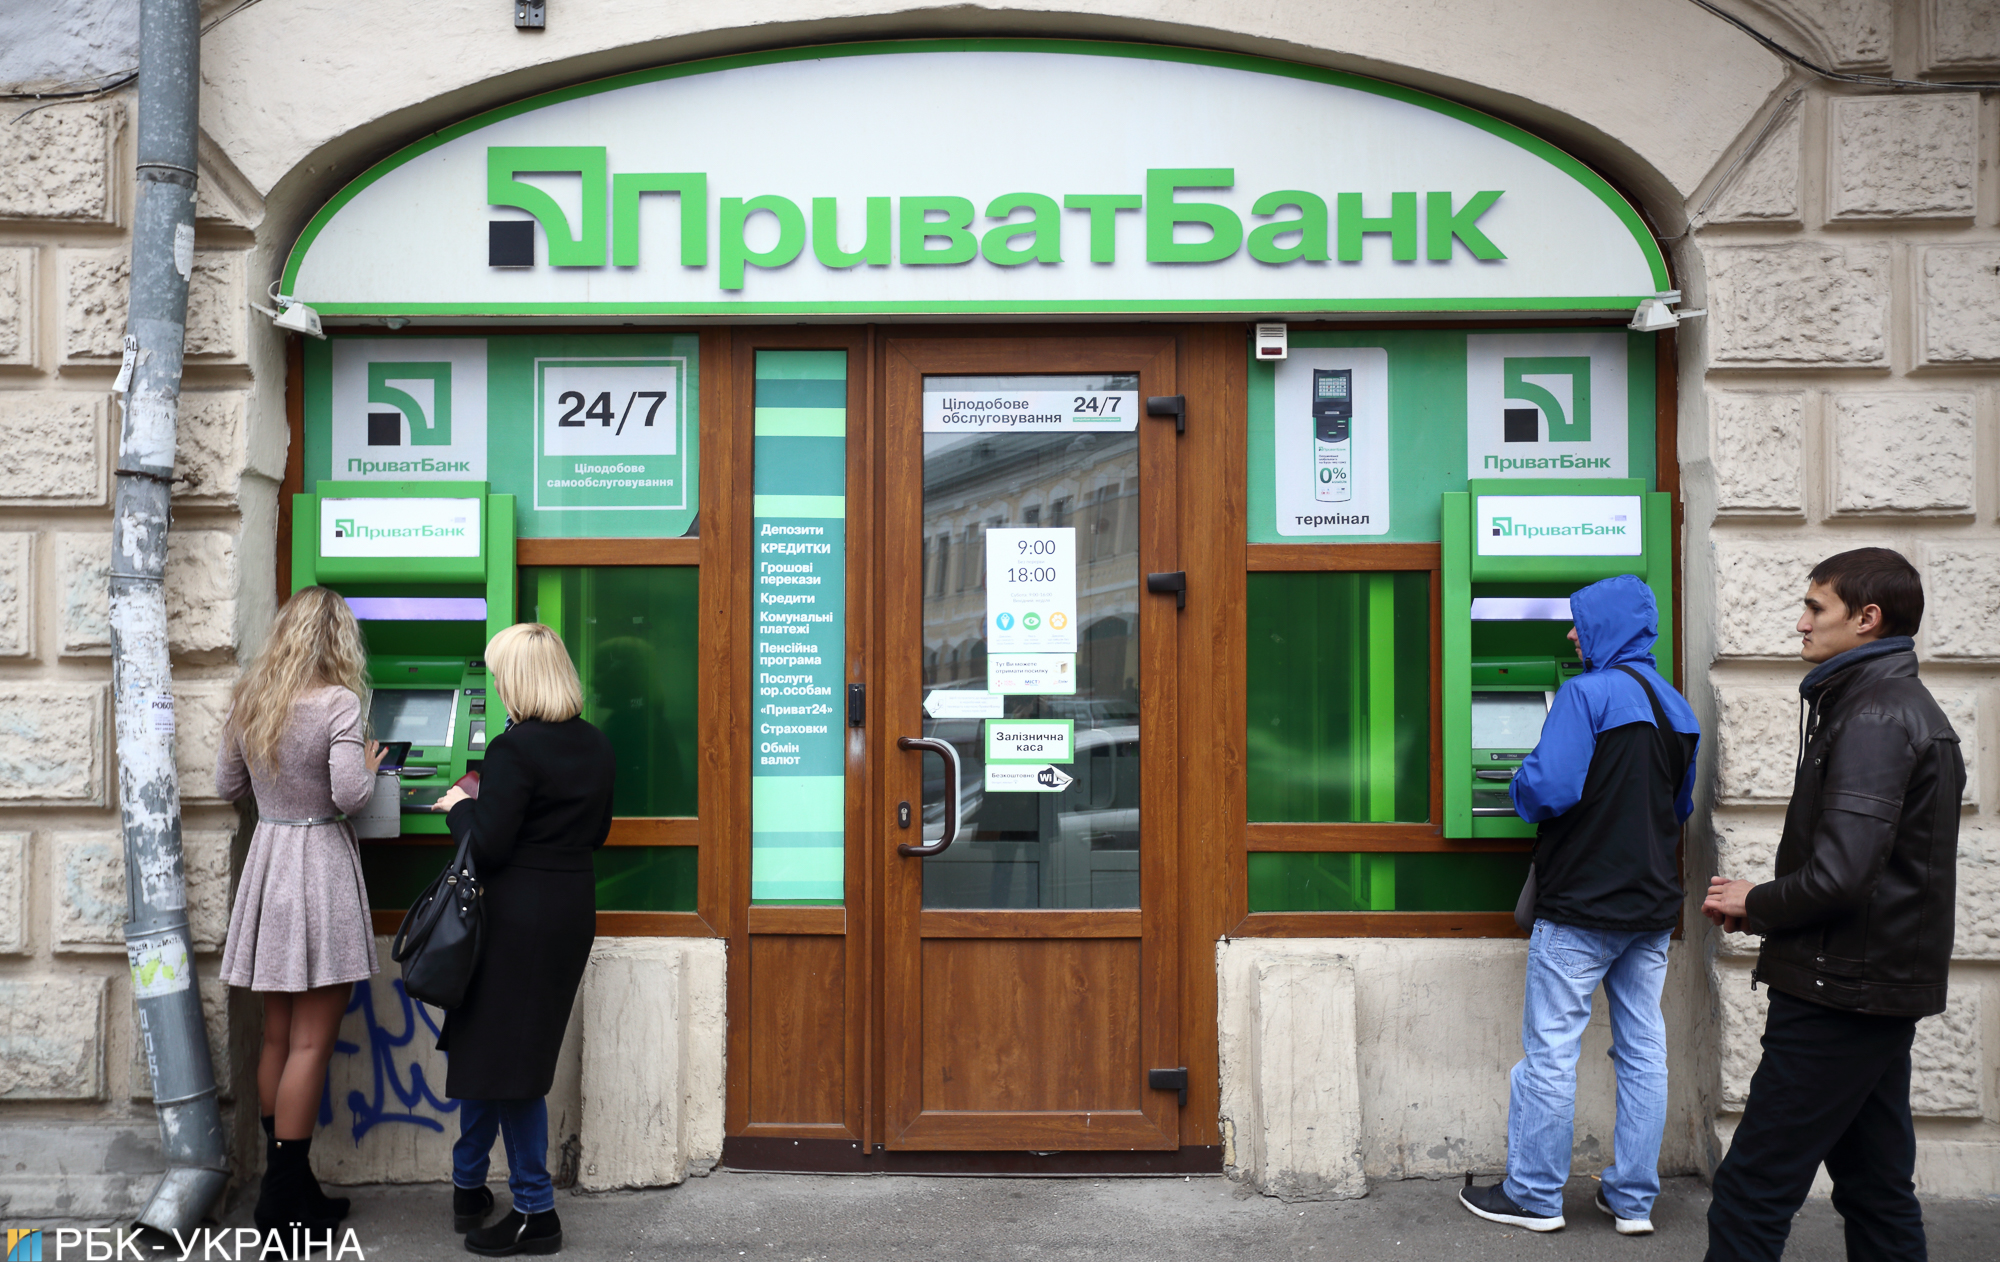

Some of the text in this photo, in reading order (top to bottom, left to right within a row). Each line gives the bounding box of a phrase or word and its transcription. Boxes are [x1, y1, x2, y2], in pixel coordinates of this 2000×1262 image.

[613, 169, 1507, 291] ПриватБанк
[942, 398, 1029, 412] Цілодобове
[1073, 396, 1122, 416] 24/7
[558, 390, 667, 436] 24/7
[942, 412, 1062, 426] обслуговування
[348, 458, 470, 475] ПриватБанк
[574, 463, 645, 475] Цілодобове
[1484, 454, 1611, 472] ПриватБанк
[1319, 467, 1347, 484] 0%
[546, 477, 674, 489] самообслуговування
[1295, 513, 1370, 528] термінал
[356, 525, 465, 540] ПриватБанк
[761, 524, 823, 536] Депозити
[1514, 523, 1626, 538] ПриватБанк
[761, 543, 831, 555] КРЕДИТКИ
[1018, 540, 1056, 555] 9:00
[761, 562, 813, 574] Грошові
[1008, 567, 1056, 582] 18:00
[761, 576, 821, 586] перекази
[761, 593, 815, 605] Кредити
[760, 612, 833, 623] Комунальні
[760, 624, 809, 634] платежі
[760, 643, 818, 653] Пенсійна
[760, 656, 821, 667] програма
[760, 673, 812, 685] Послуги
[761, 686, 831, 697] юр.особам
[761, 704, 832, 716] «Приват24»
[761, 723, 827, 736] Страховки
[996, 731, 1064, 742] Залізнична
[761, 742, 799, 753] Обмін
[1016, 744, 1044, 752] каса
[761, 756, 800, 764] валют
